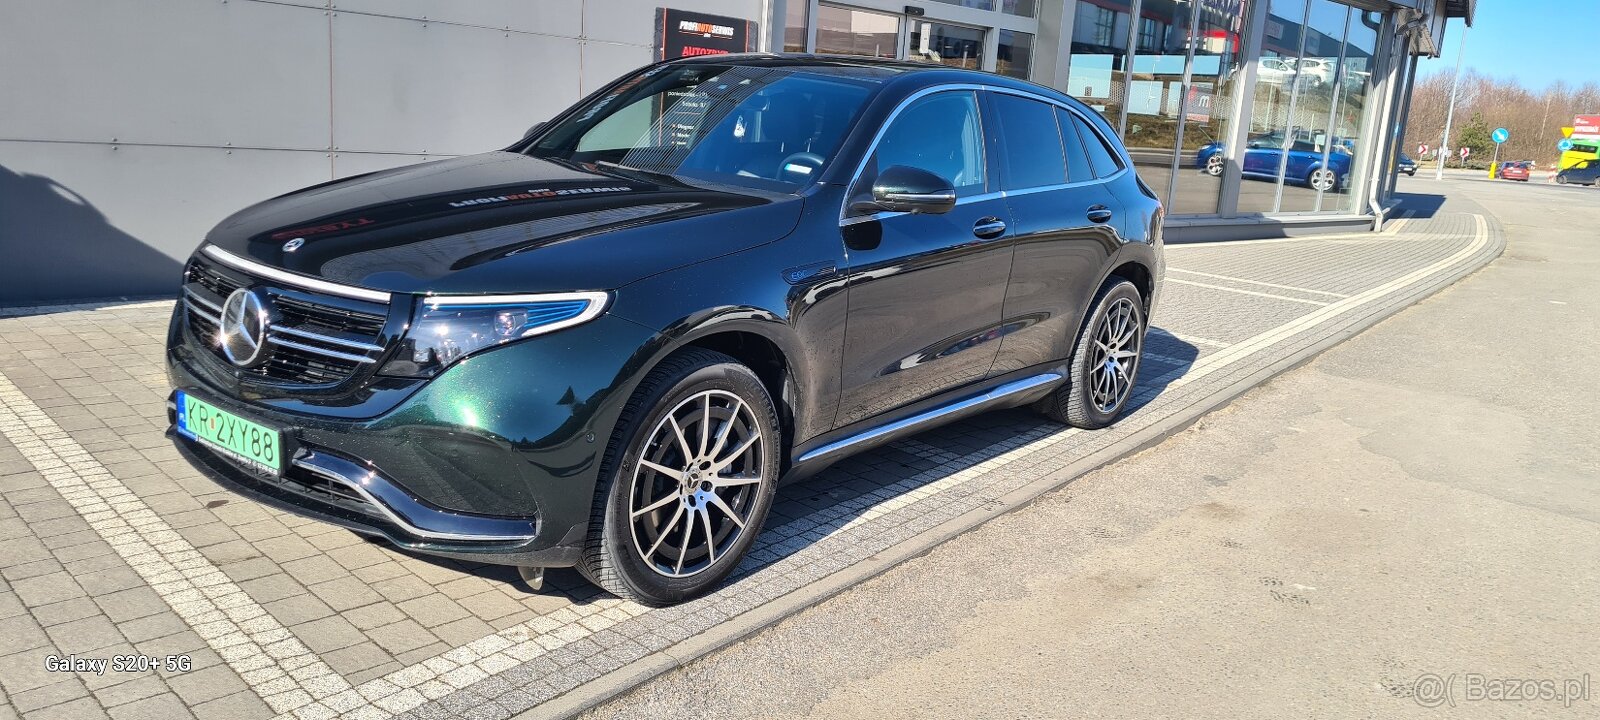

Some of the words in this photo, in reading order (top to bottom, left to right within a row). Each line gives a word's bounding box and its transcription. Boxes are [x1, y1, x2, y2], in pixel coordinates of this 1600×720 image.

[679, 21, 734, 36] PROFIAUTOSERWIS
[188, 399, 209, 436] KR
[216, 412, 274, 462] 2XY88
